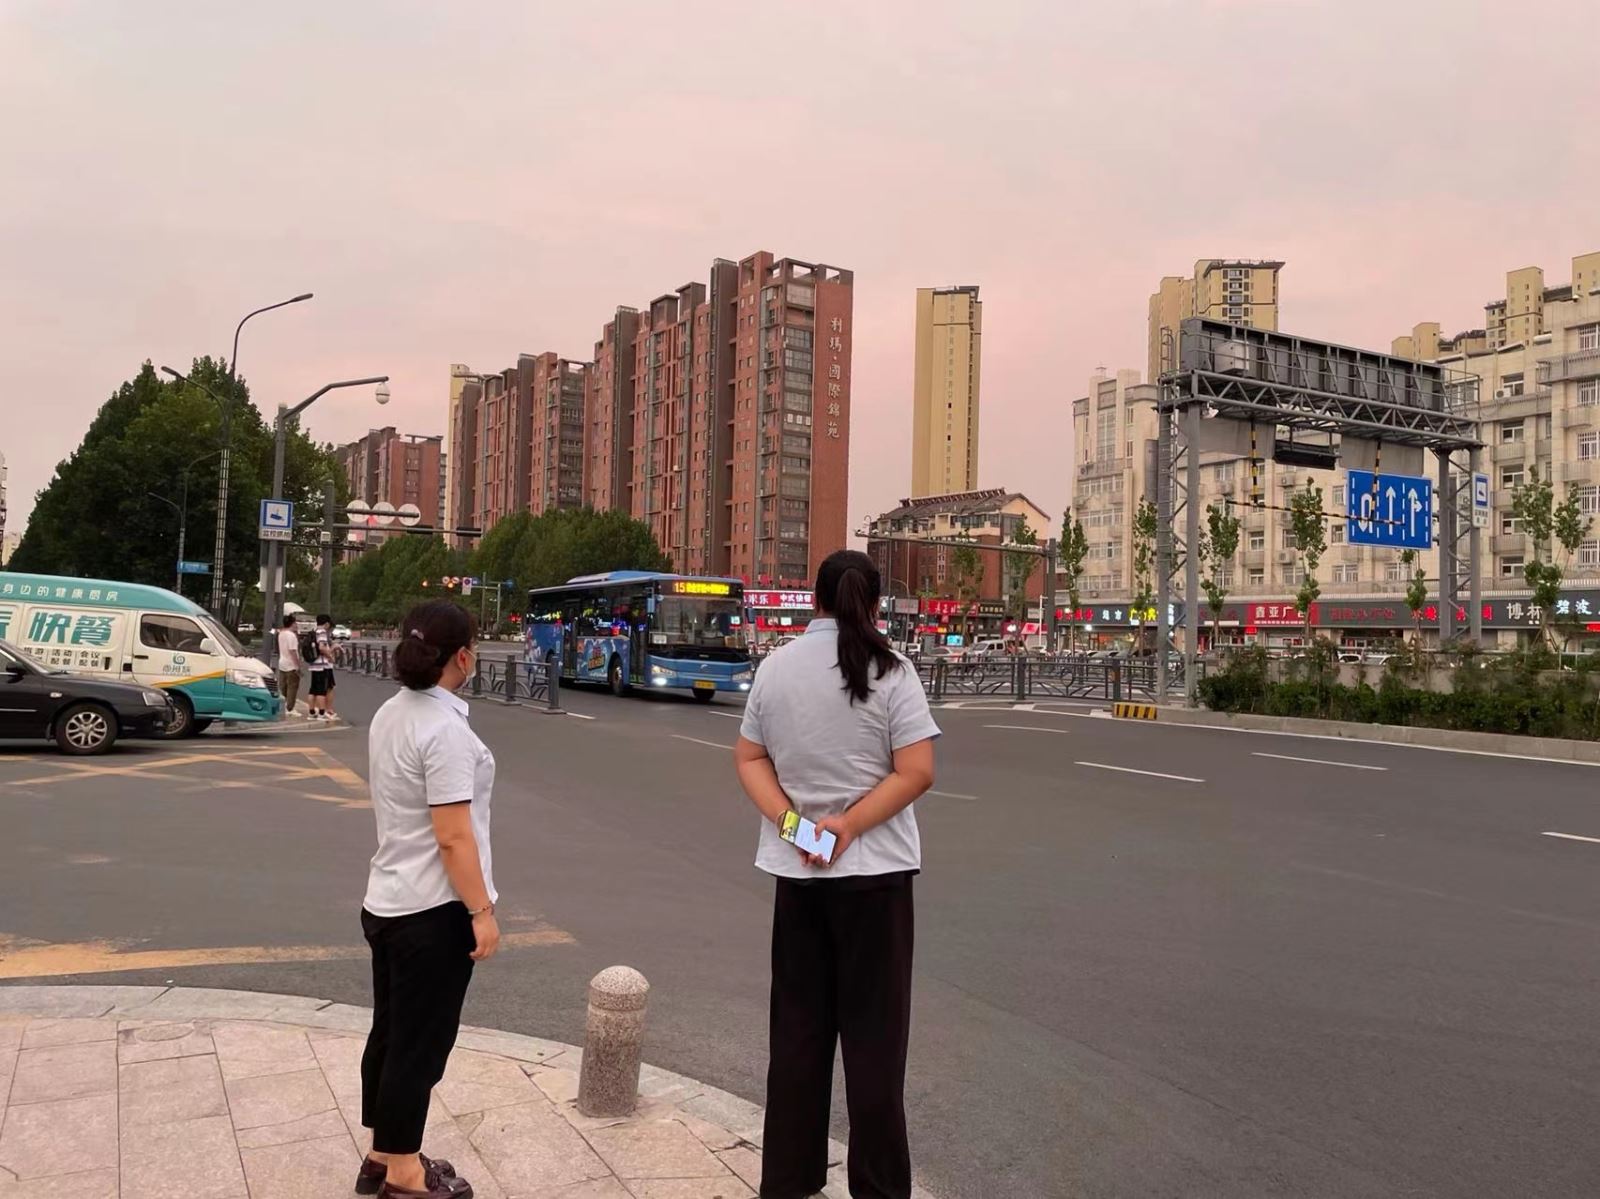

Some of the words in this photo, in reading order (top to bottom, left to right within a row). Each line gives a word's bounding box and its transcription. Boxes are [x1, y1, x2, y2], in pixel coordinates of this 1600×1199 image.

[2, 583, 119, 601] 身边的健康厨房
[675, 582, 686, 593] 15
[1555, 599, 1600, 615] 碧波
[80, 650, 101, 659] 会议
